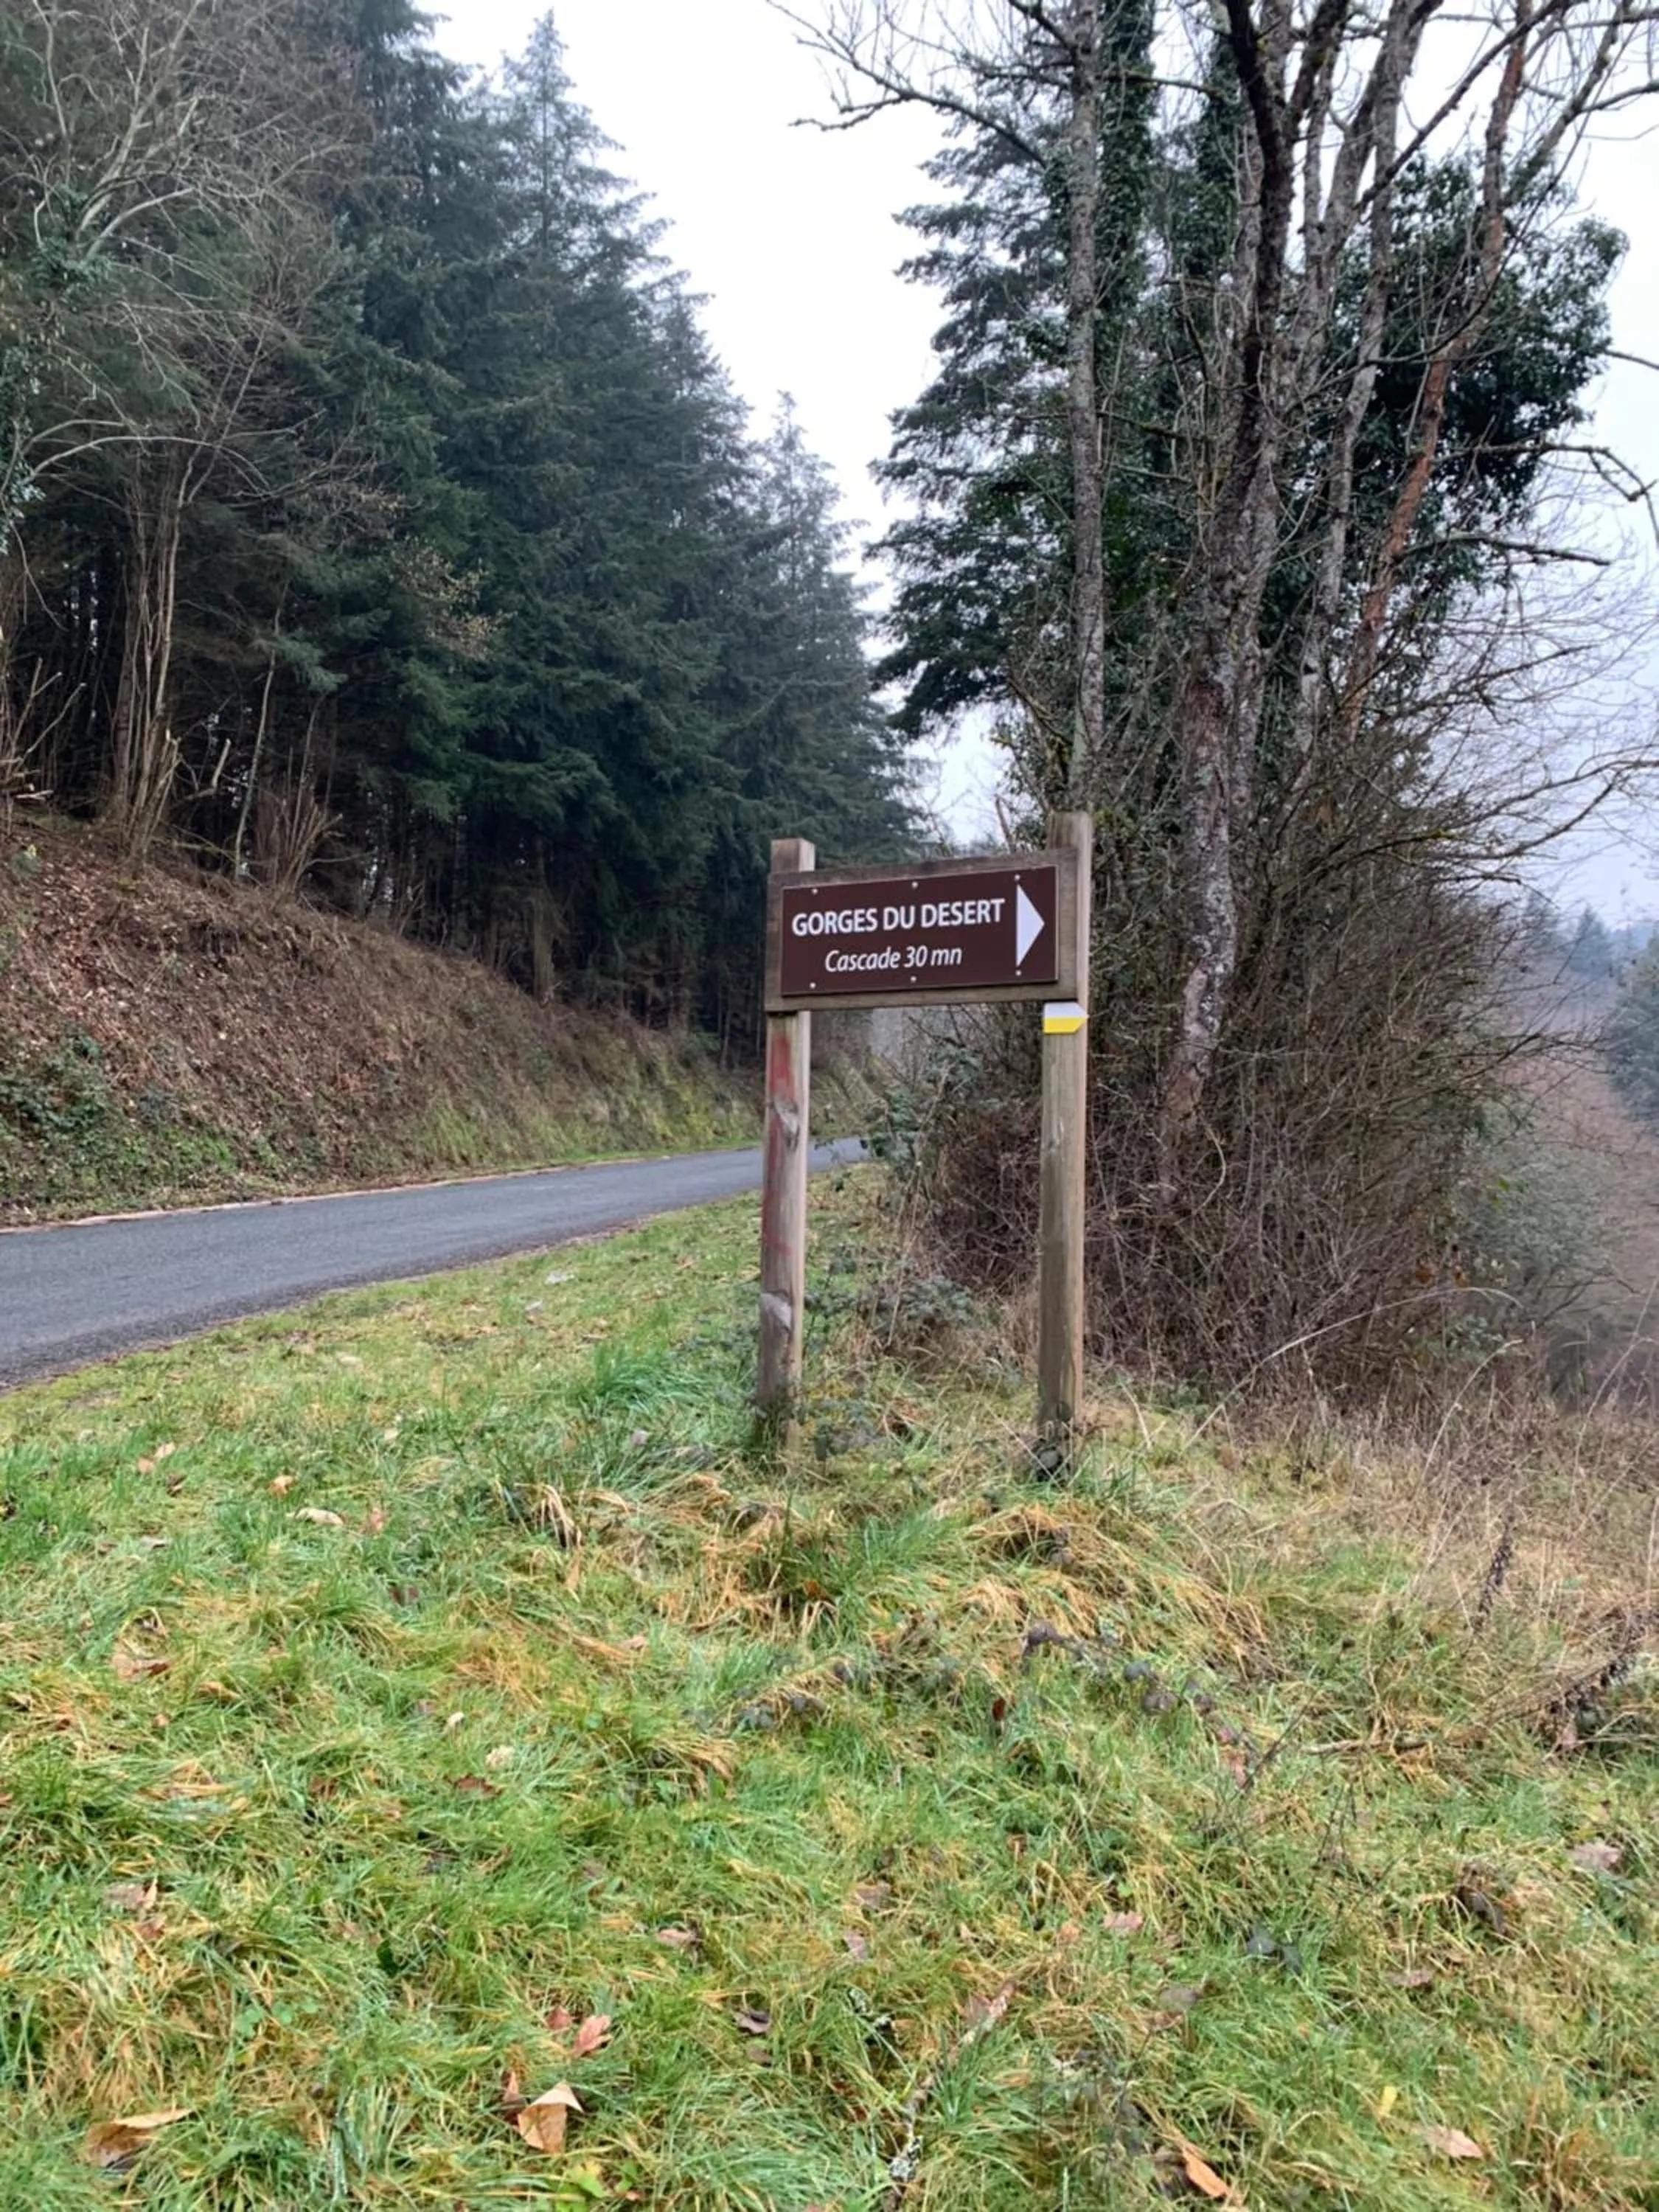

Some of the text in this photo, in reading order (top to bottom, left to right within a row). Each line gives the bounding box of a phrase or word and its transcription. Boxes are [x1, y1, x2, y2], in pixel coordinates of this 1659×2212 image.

[792, 898, 1006, 936] GORGES DU DESERT
[825, 945, 963, 973] Cascade 30 mn
